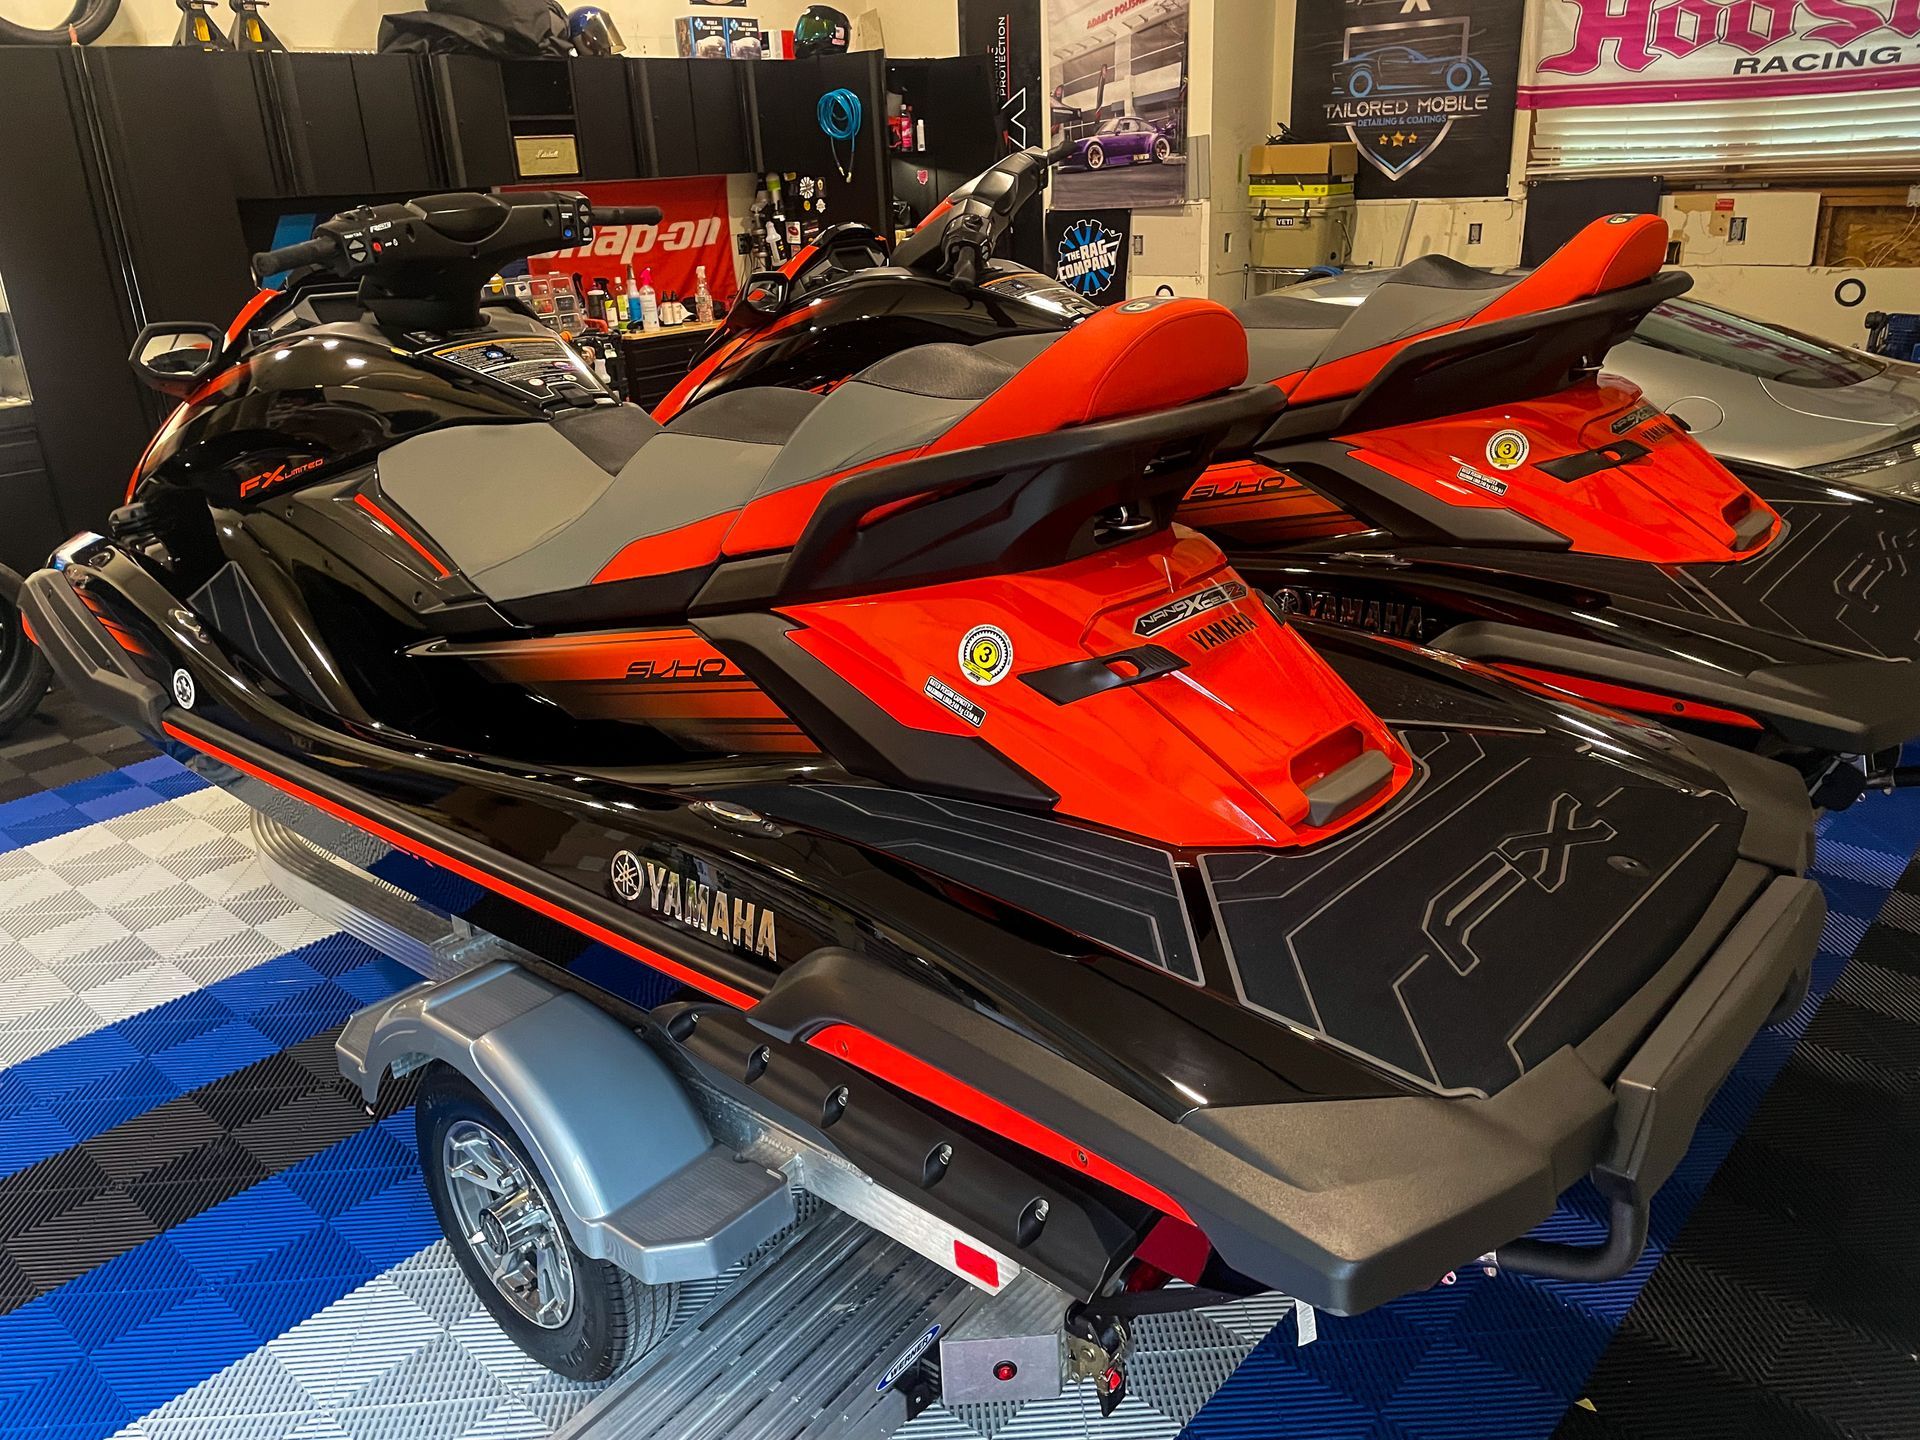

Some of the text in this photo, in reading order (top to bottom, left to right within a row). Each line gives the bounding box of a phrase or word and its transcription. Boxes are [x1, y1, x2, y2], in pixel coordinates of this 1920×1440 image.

[998, 16, 1007, 96] PROTECTION
[1732, 46, 1902, 75] RACING
[1323, 94, 1489, 119] TAILORED MOBILE
[1357, 117, 1397, 127] DETAILING
[1407, 114, 1447, 125] COATINGS
[527, 217, 721, 264] ap-on
[1065, 239, 1110, 262] THE RAG
[1058, 251, 1117, 280] COMPANY
[1502, 443, 1512, 455] 3
[240, 458, 324, 498] FX LIMITED
[1188, 476, 1286, 498] SVHO
[1305, 591, 1424, 640] YAMAHA
[1188, 612, 1259, 651] YAMAHA
[625, 658, 727, 678] SVHO
[979, 646, 992, 663] 3
[1421, 792, 1618, 977] FX
[646, 861, 777, 962] YAMAHA
[890, 1335, 929, 1379] WERNER
